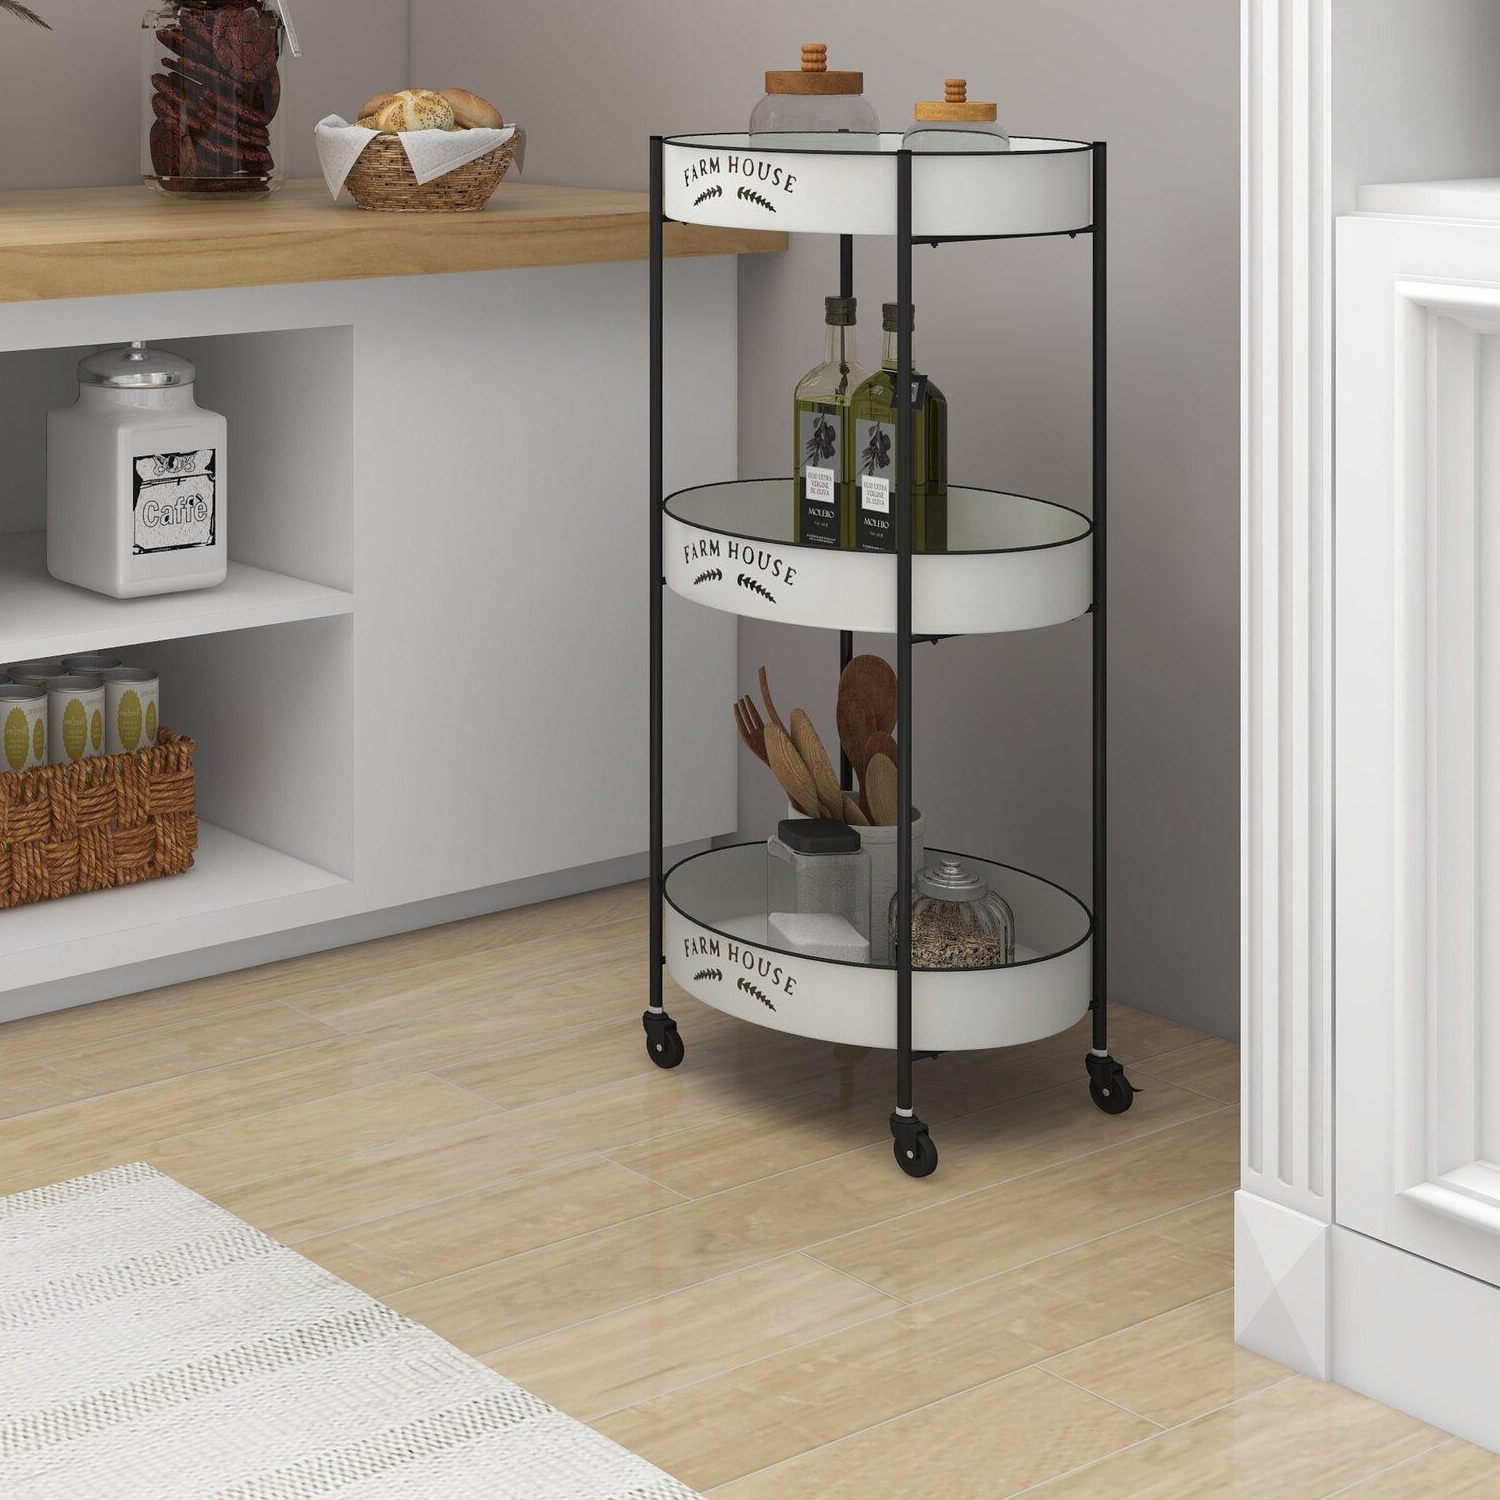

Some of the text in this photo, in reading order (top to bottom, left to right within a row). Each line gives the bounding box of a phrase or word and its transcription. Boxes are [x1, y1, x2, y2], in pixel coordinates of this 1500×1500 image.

[684, 155, 797, 193] FARM HOUSE
[142, 493, 208, 528] Caffè
[684, 539, 797, 586] FARM HOUSE
[684, 936, 797, 996] FARM HOUSE
